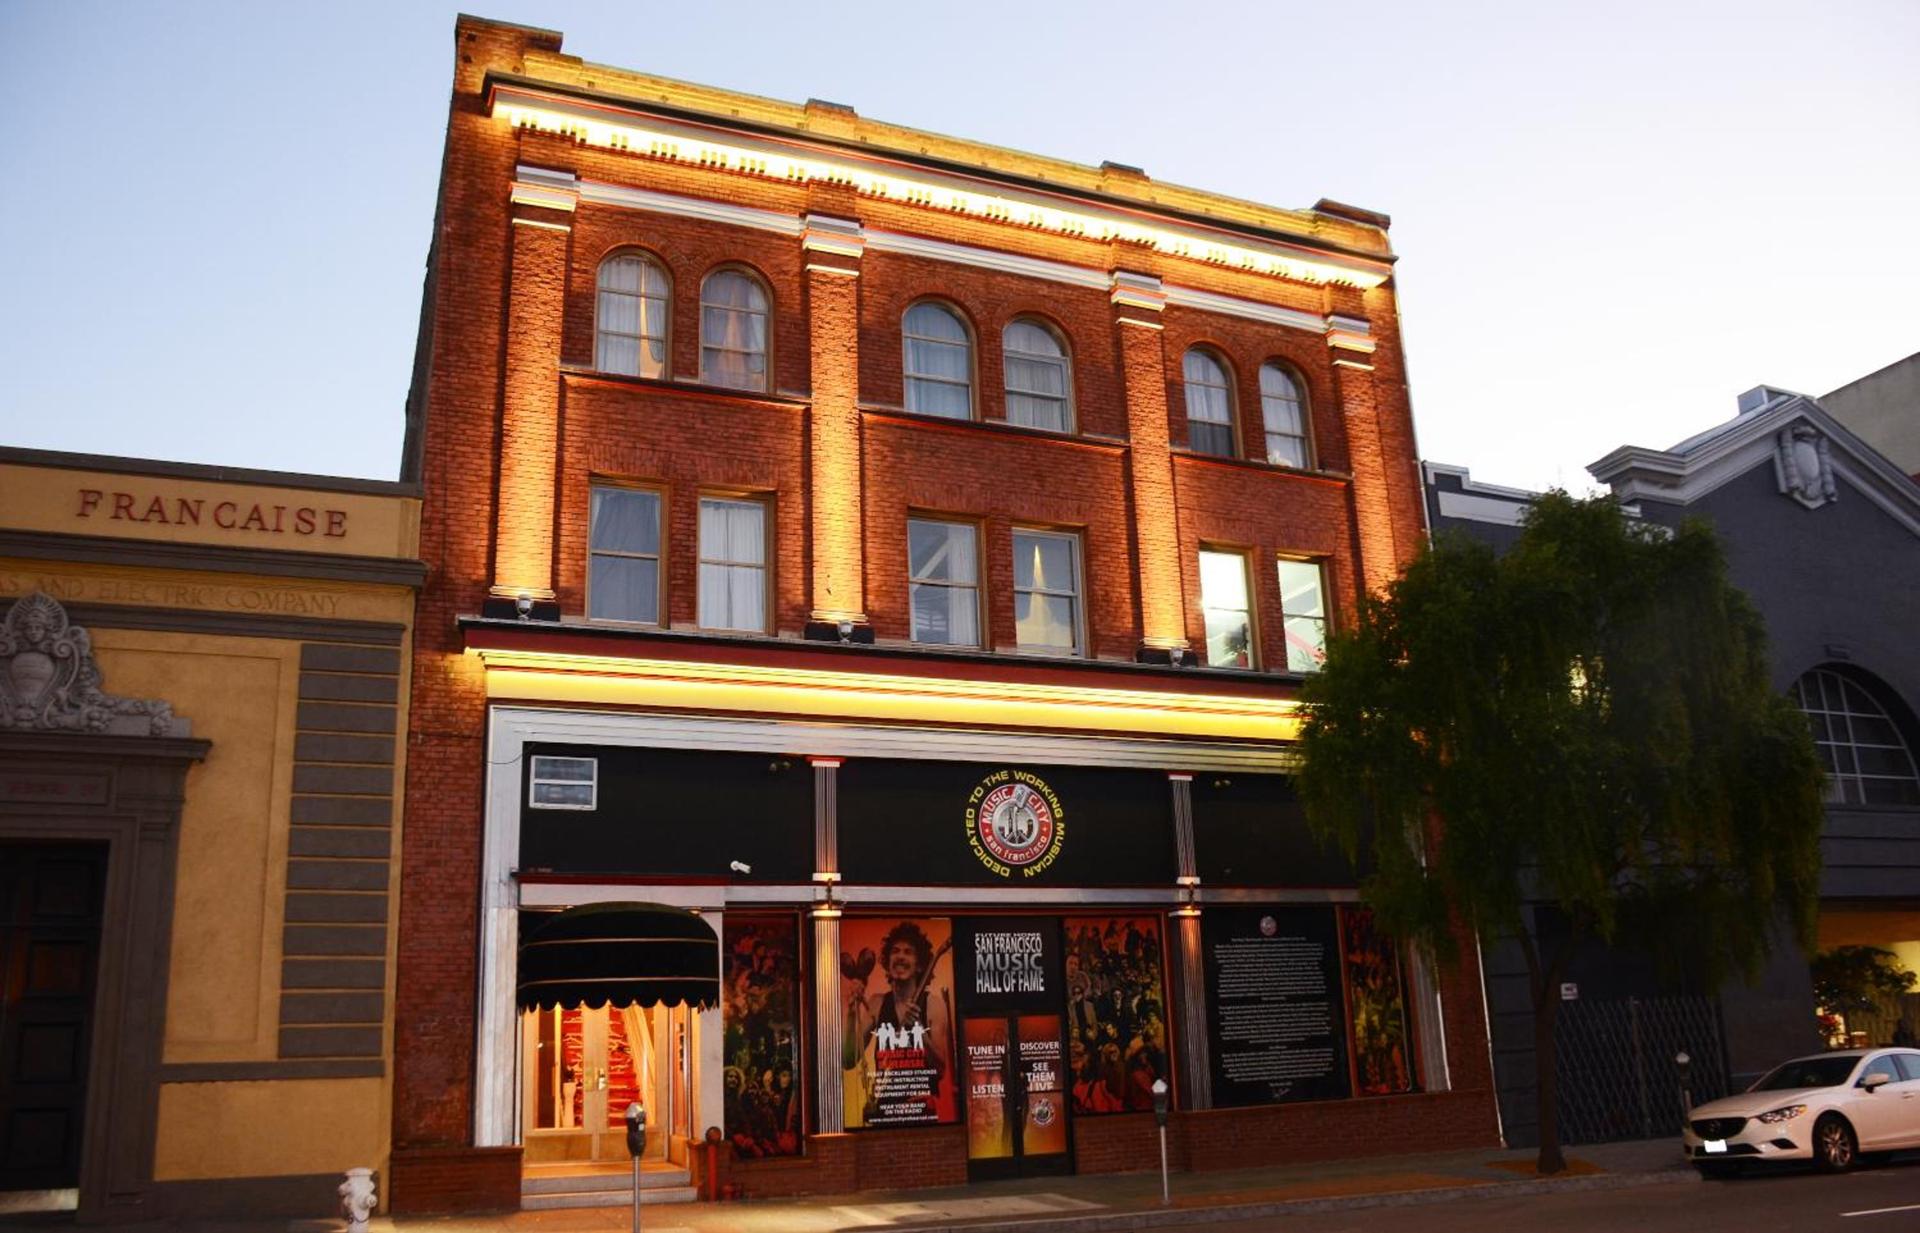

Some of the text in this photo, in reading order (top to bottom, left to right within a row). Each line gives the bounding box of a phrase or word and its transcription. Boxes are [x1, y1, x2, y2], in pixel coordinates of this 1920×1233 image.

[75, 488, 347, 538] FRANCAISE
[37, 576, 85, 599] AND
[224, 585, 340, 616] COMPANY
[981, 788, 1050, 825] MUSIC CITY
[965, 770, 1066, 878] DEDICATED TO THE WORKING MUSICIAN
[985, 835, 1003, 855] san
[975, 936, 1043, 954] SAN FRANCISCO
[976, 953, 1043, 971] MUSIC
[976, 970, 1045, 993] HALL OF FAME
[968, 1045, 1006, 1056] TUNE IN
[1020, 1041, 1060, 1051] DISCOVER
[1032, 1062, 1049, 1072] SEE
[1026, 1071, 1056, 1083] THEM
[972, 1084, 1005, 1095] LISTEN
